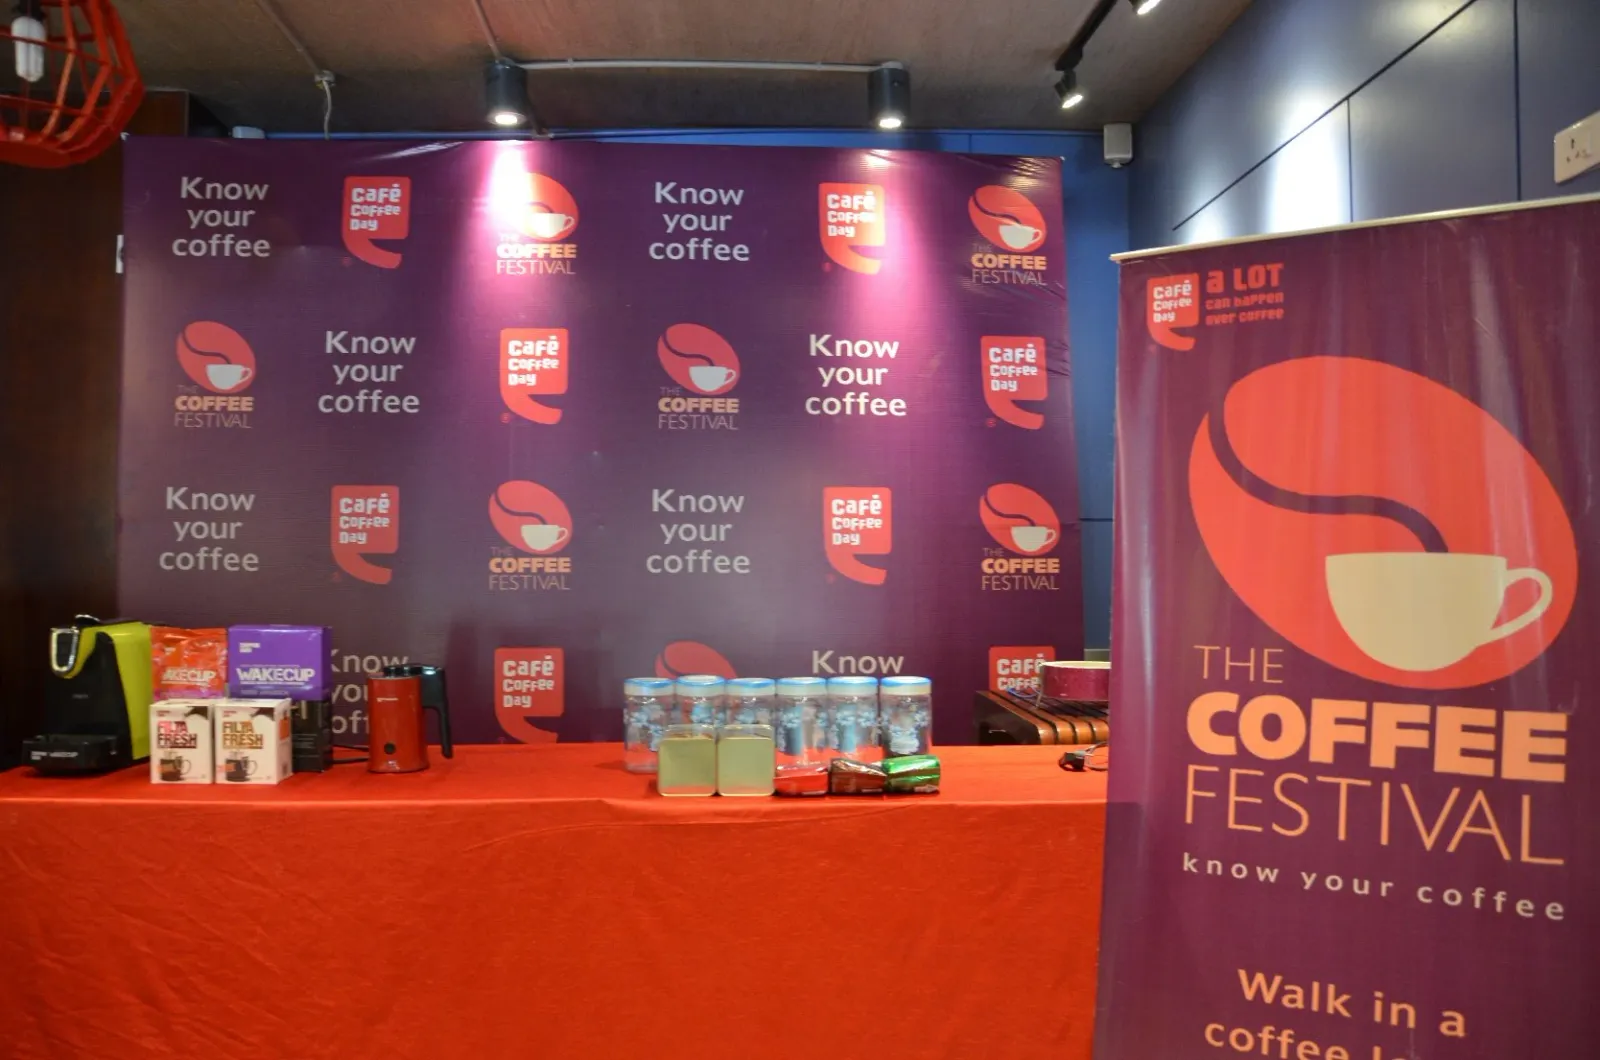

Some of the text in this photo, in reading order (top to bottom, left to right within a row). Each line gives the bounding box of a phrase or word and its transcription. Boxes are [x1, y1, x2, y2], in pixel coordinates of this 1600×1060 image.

[180, 176, 269, 201] Know
[654, 181, 744, 206] Know
[187, 207, 256, 229] your
[662, 212, 733, 233] your
[172, 234, 271, 258] coffee
[496, 243, 577, 259] COFFEE
[648, 240, 750, 262] coffee
[496, 259, 576, 275] FESTIVAL
[971, 254, 1046, 270] COFFEE
[971, 270, 1047, 286] FESTIVAL
[1233, 262, 1285, 291] LOT
[1205, 292, 1284, 310] can happen
[1153, 311, 1176, 323] Day
[1205, 308, 1284, 326] over coffee
[325, 330, 416, 355] Know
[809, 334, 899, 358] Know
[333, 362, 403, 384] your
[818, 365, 888, 387] your
[318, 391, 420, 414] coffee
[659, 387, 680, 396] THE
[175, 396, 254, 412] COFFEE
[658, 398, 739, 413] COFFEE
[805, 393, 907, 417] coffee
[174, 412, 252, 429] FESTIVAL
[658, 414, 738, 430] FESTIVAL
[165, 486, 256, 512] Know
[652, 488, 745, 513] Know
[173, 519, 243, 541] your
[660, 520, 732, 543] your
[159, 548, 259, 571] coffee
[490, 546, 513, 556] THE
[645, 550, 751, 574] coffee
[982, 547, 1004, 557] THE
[489, 557, 571, 574] COFFEE
[981, 558, 1060, 574] COFFEE
[489, 574, 570, 591] FESTIVAL
[981, 575, 1059, 590] FESTIVAL
[812, 650, 904, 674] Know
[1193, 645, 1284, 684] THE
[236, 668, 316, 682] WAKECUP
[997, 677, 1039, 693] Coffe
[157, 733, 197, 746] FRESH
[222, 733, 263, 746] FRESH
[1186, 691, 1568, 783] COFFEE
[1184, 764, 1565, 866] FESTIVAL
[1183, 852, 1565, 922] know your coffee
[1237, 968, 1466, 1038] Walk in a
[1205, 1022, 1350, 1060] coffee
